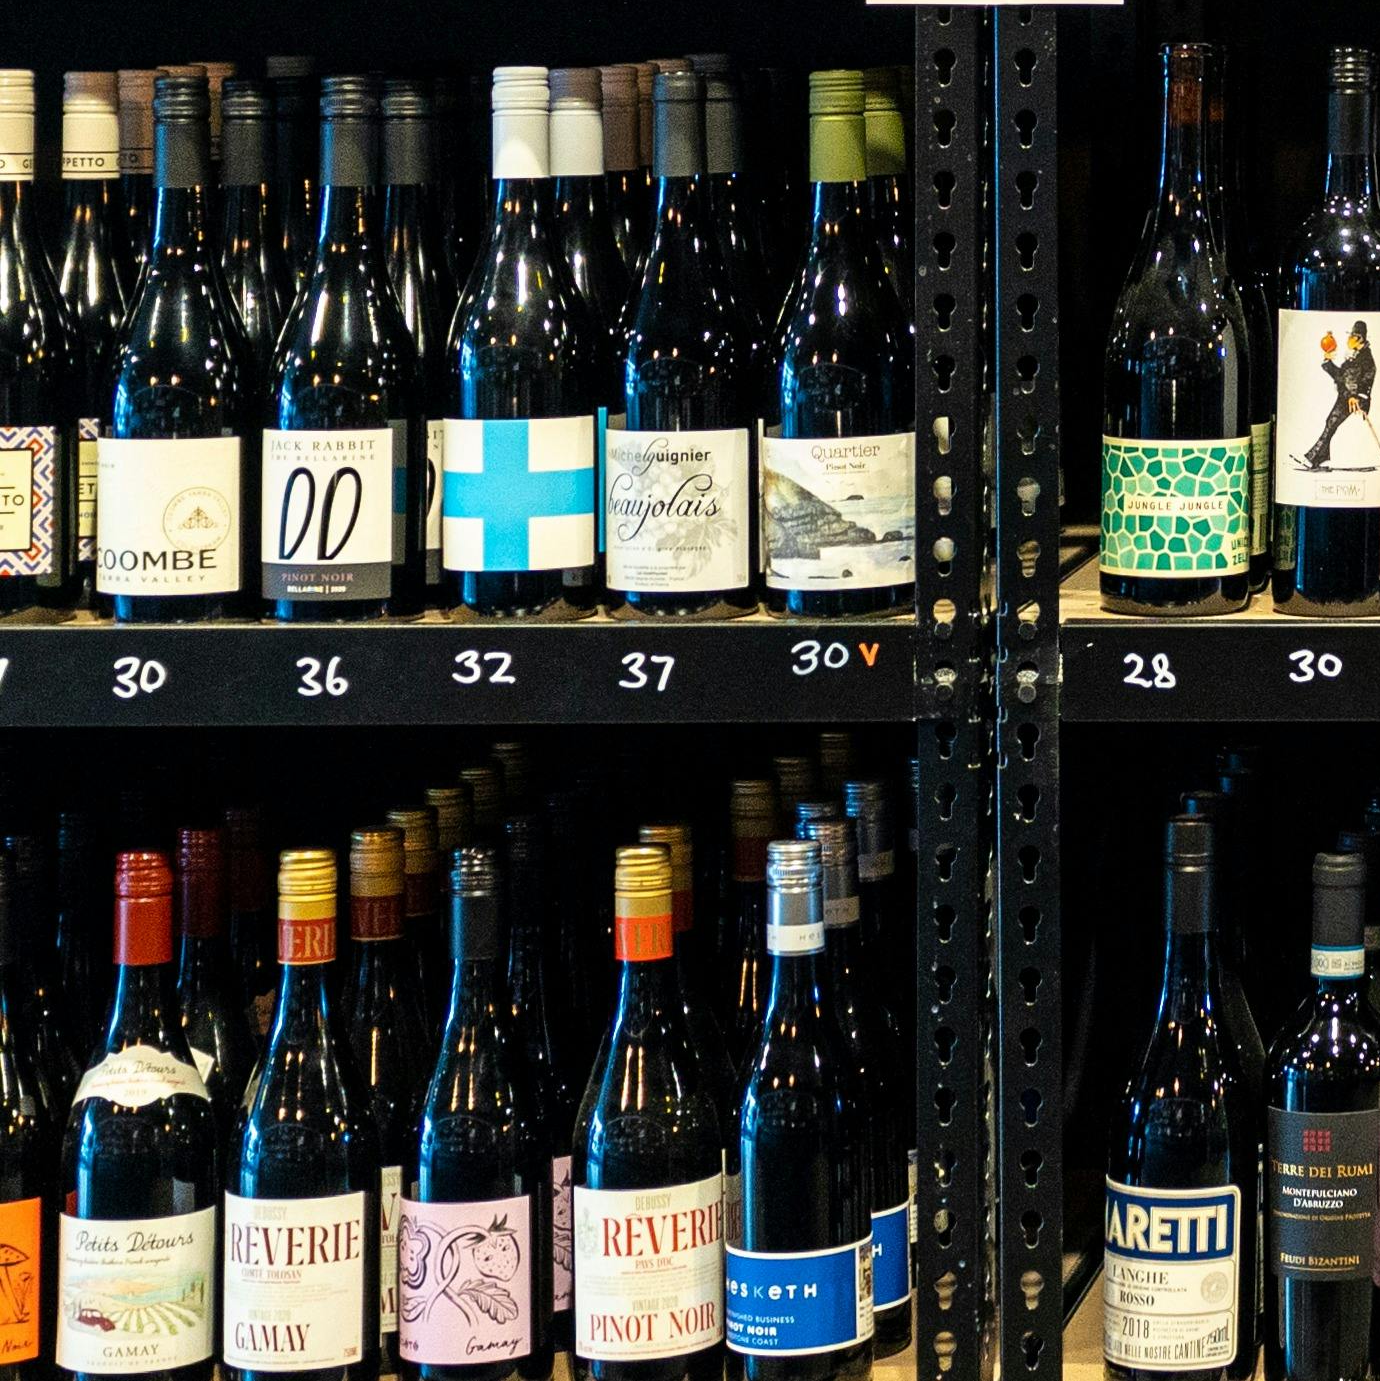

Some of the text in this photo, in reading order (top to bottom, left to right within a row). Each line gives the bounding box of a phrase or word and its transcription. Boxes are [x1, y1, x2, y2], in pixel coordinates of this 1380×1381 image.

[271, 440, 376, 451] JACK RABBIT
[811, 444, 880, 461] Quartier
[608, 474, 721, 541] beaujolais
[1128, 500, 1224, 511] JUNGLE JUNGLE
[451, 649, 517, 685] 32
[618, 651, 675, 692] 37
[790, 639, 850, 676] 30
[1123, 652, 1177, 689] 28
[1288, 649, 1343, 683] 30
[112, 656, 168, 699] 30
[295, 655, 349, 697] 36
[75, 1230, 193, 1253] Petits Détours
[235, 1324, 311, 1351] GAMAY
[590, 1301, 716, 1340] PINOT NOIR
[103, 1344, 159, 1358] GAMAY
